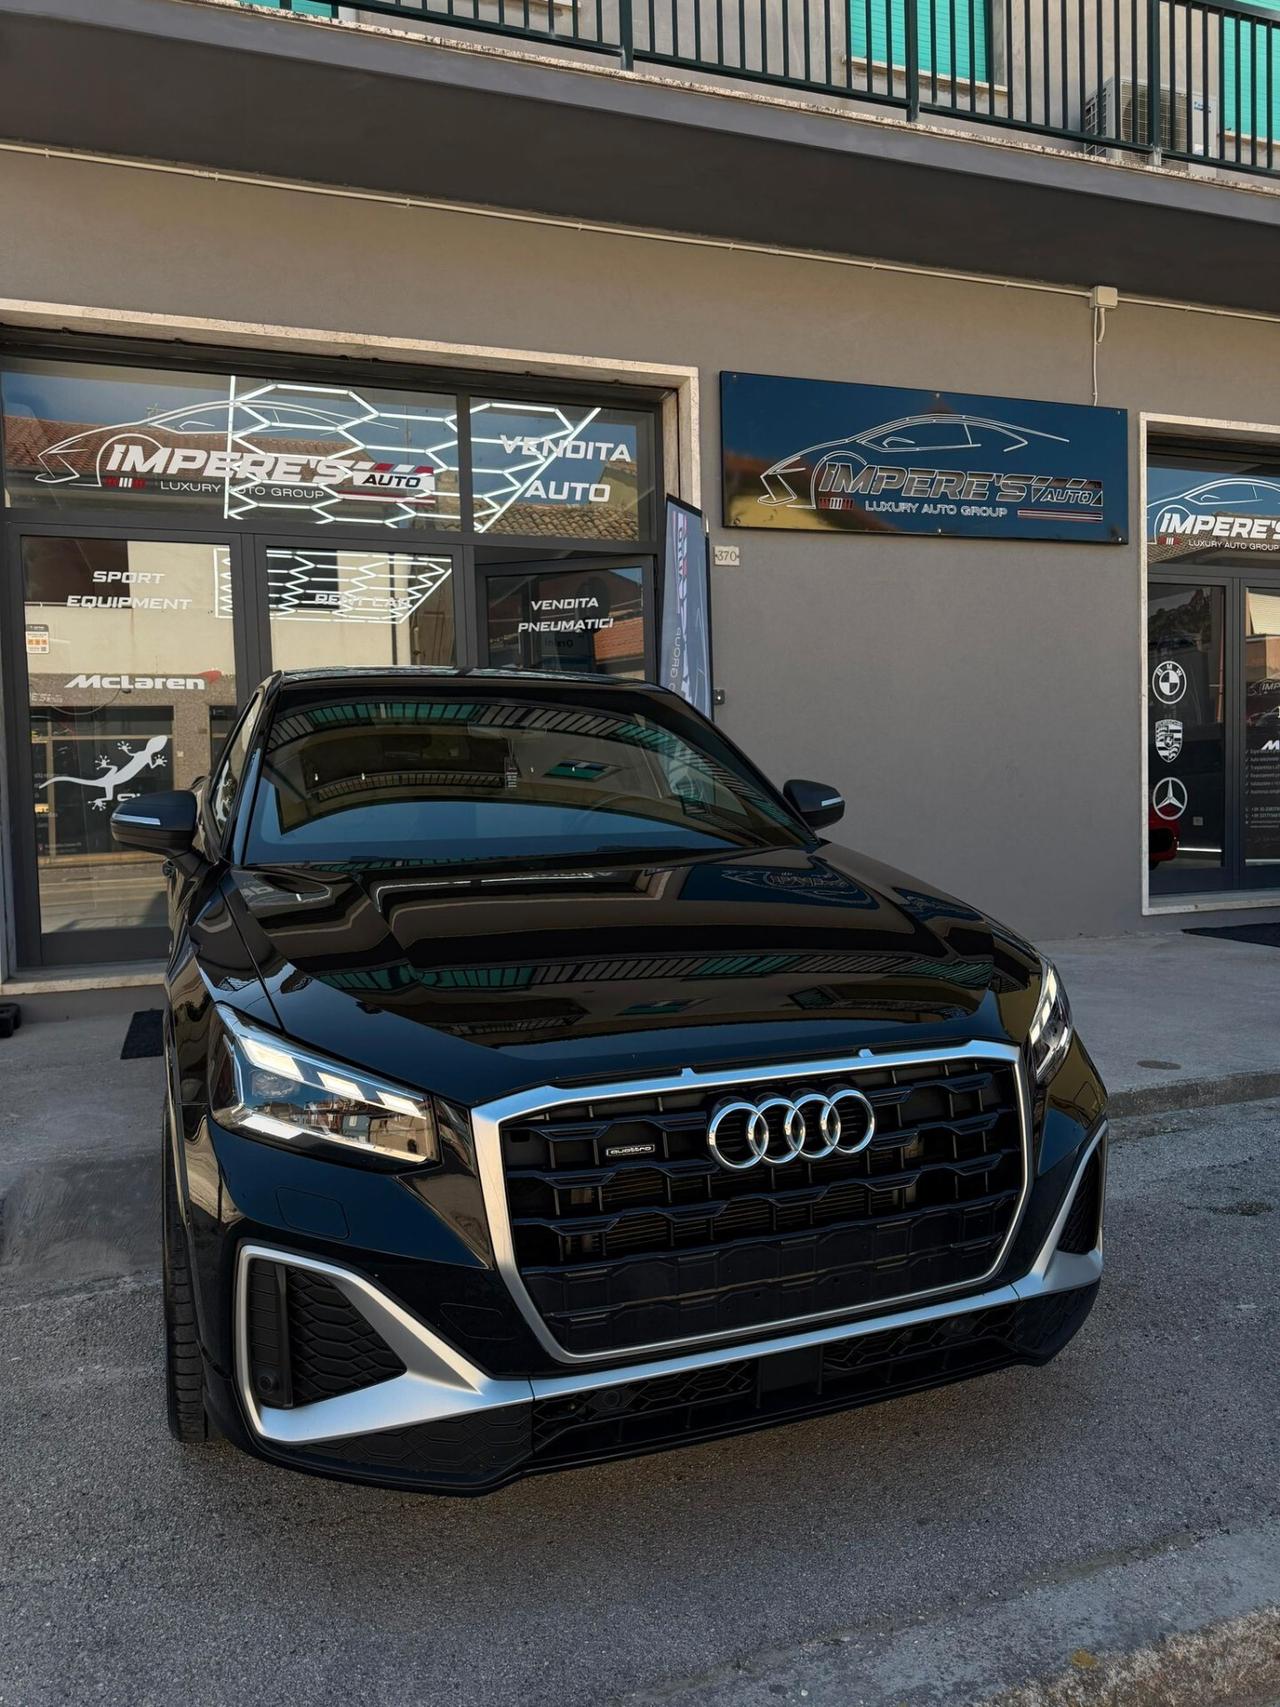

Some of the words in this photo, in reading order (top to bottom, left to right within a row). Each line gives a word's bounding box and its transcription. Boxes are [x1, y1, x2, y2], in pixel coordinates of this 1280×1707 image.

[500, 435, 631, 462] VENDITA
[106, 444, 355, 485] IMPERE'S
[362, 474, 421, 488] AUTO
[817, 461, 1036, 502] IMPERE'S
[160, 480, 221, 493] LUXURY
[271, 487, 324, 499] GROUP
[524, 480, 611, 502] AUTO
[1047, 489, 1093, 504] AUTO
[865, 500, 918, 513] LUXURY
[921, 503, 957, 515] AUTO
[960, 505, 1008, 518] GROUP
[1189, 540, 1222, 548] LUXURY
[1224, 542, 1247, 550] AUTO
[1249, 543, 1280, 551] GROUP
[717, 550, 737, 562] 370
[93, 571, 165, 584] SPORT
[66, 595, 192, 610] EQUIPMENT
[531, 597, 599, 611] VENDITA
[518, 617, 614, 633] PNEUMATICI
[64, 674, 205, 690] McLaren
[610, 1146, 652, 1155] quattro
